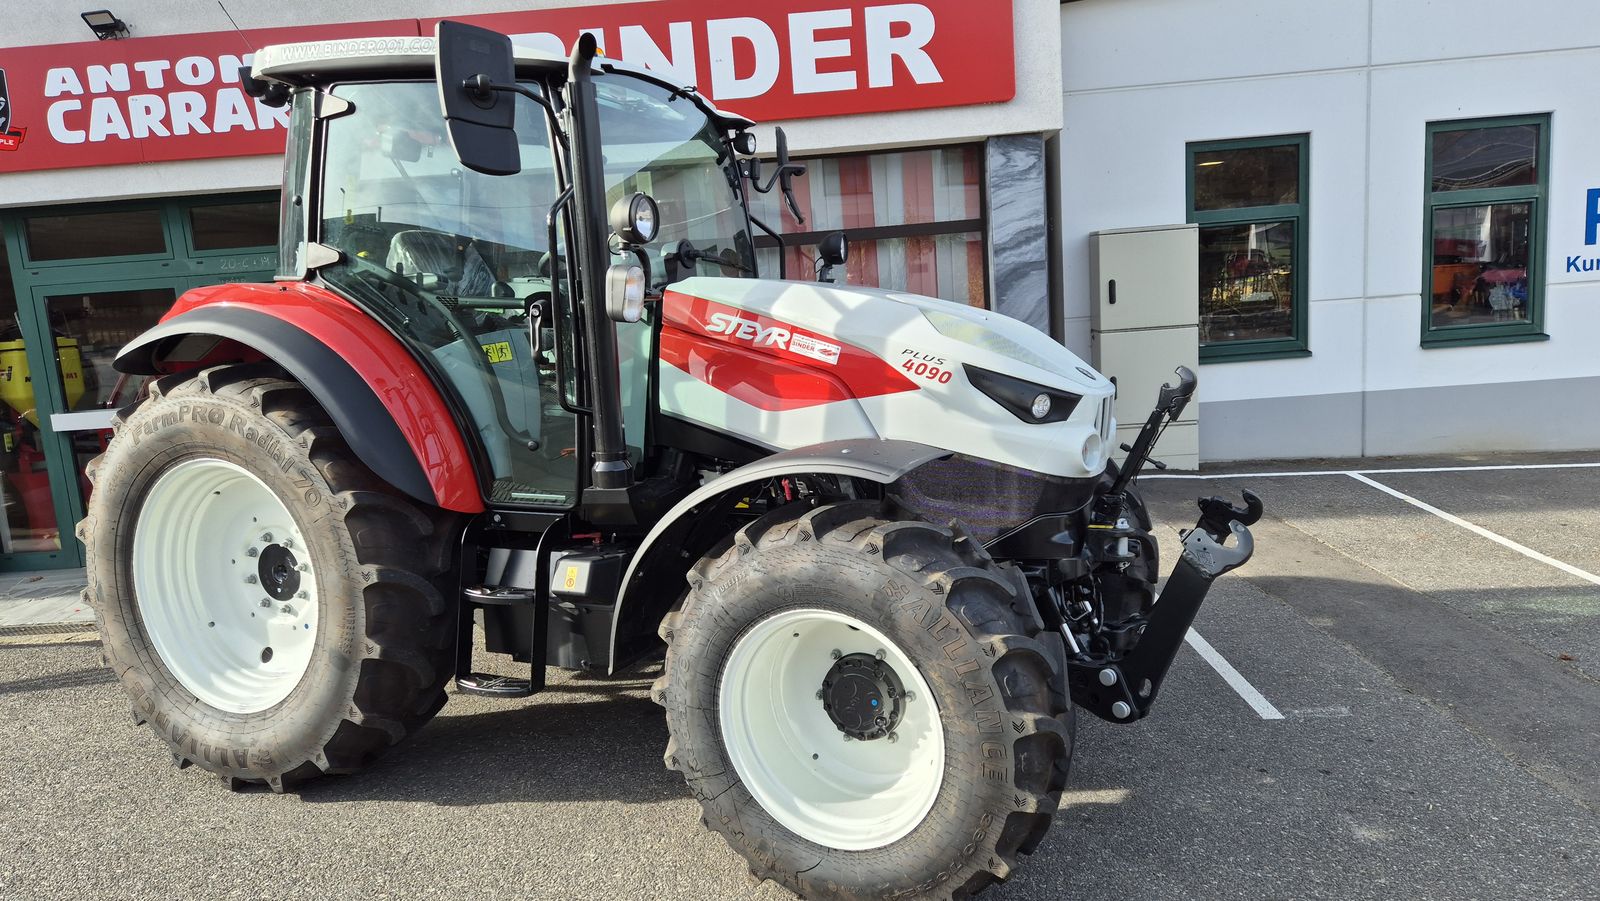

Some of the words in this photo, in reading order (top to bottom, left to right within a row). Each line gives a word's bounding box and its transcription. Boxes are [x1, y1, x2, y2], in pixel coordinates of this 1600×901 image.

[705, 312, 791, 350] STEYR
[901, 348, 947, 366] PLUS
[902, 358, 953, 384] 4090
[131, 405, 226, 445] FarmPRO
[229, 412, 296, 474] Radial
[899, 596, 1008, 785] ALLIANCE
[129, 680, 250, 769] ALLIANCE
